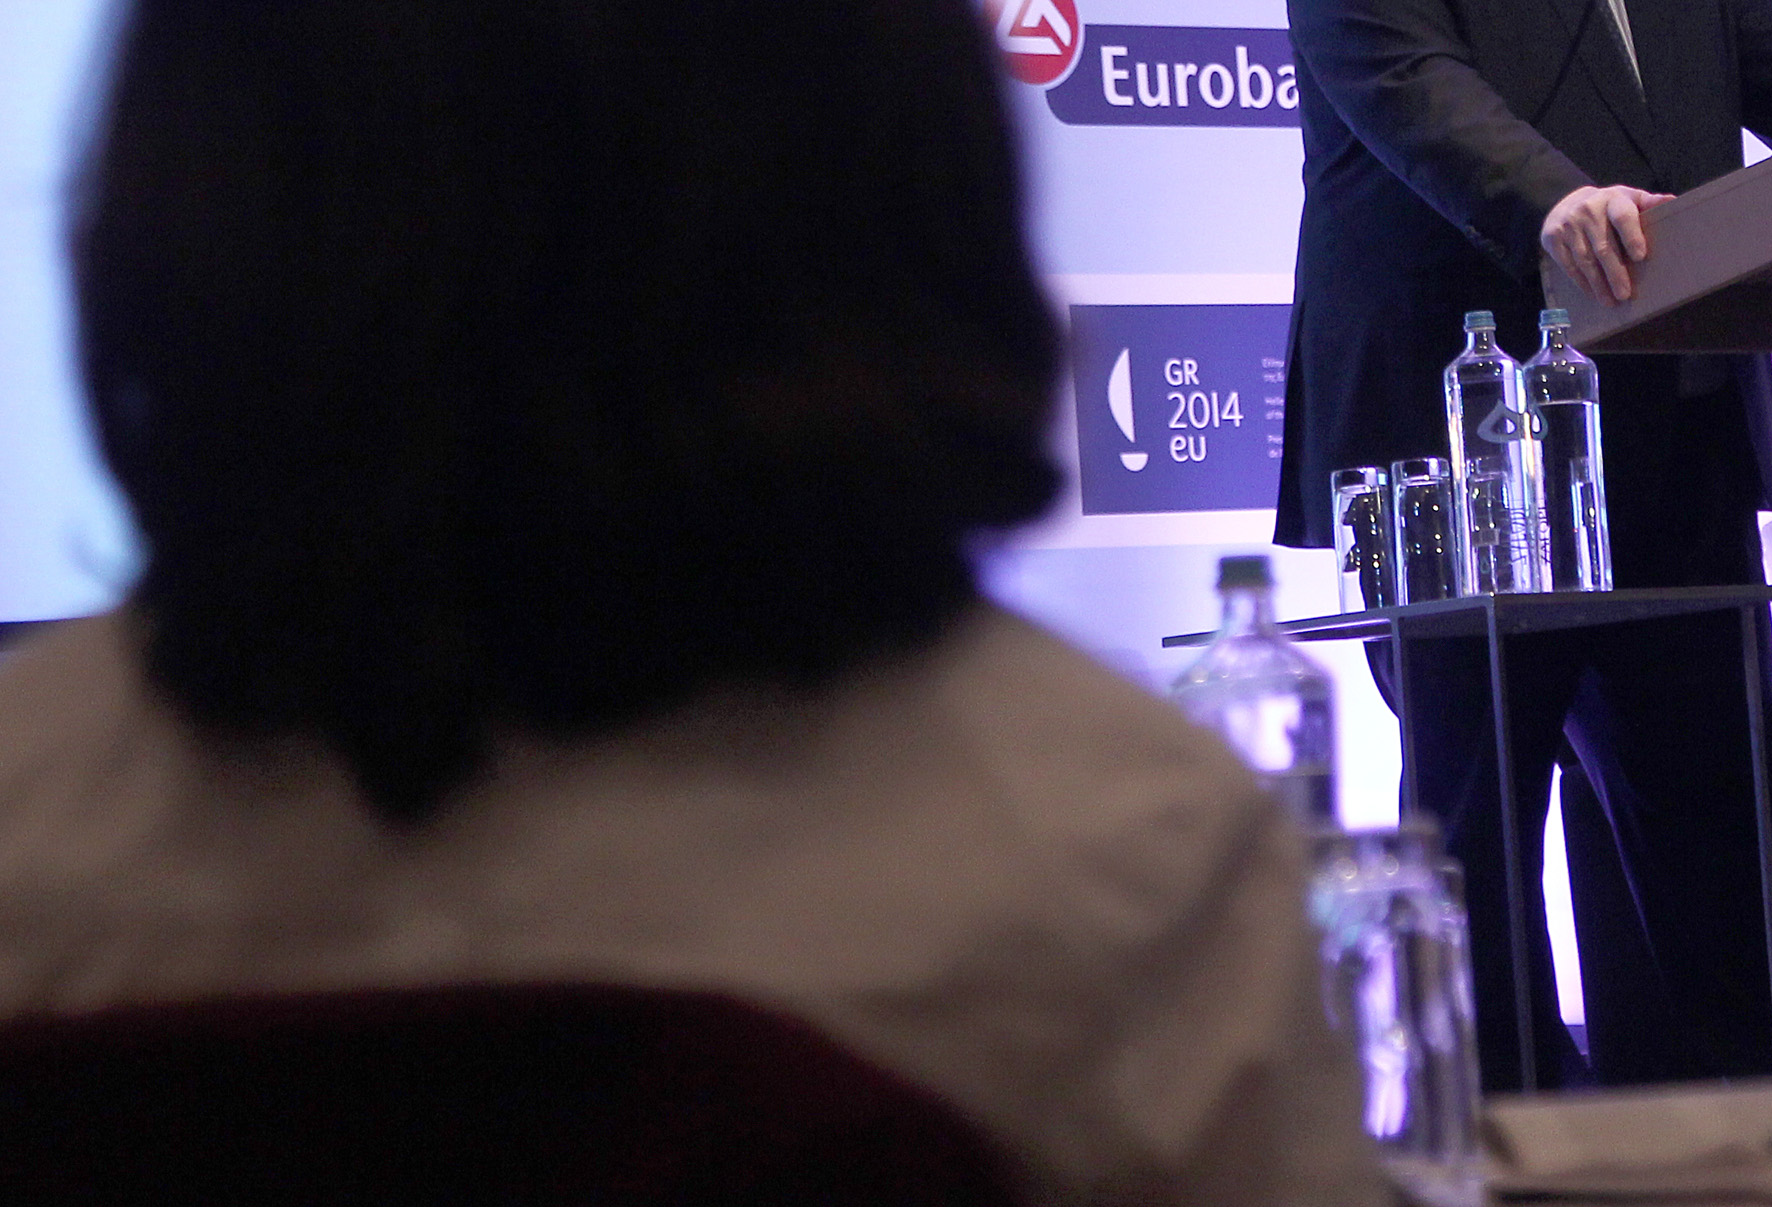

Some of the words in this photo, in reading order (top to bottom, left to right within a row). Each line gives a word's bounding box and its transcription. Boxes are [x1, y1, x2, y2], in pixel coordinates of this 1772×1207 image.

[1100, 45, 1300, 110] Euroba
[1164, 357, 1200, 386] GR
[1166, 391, 1244, 429] 2014
[1169, 433, 1208, 463] eu
